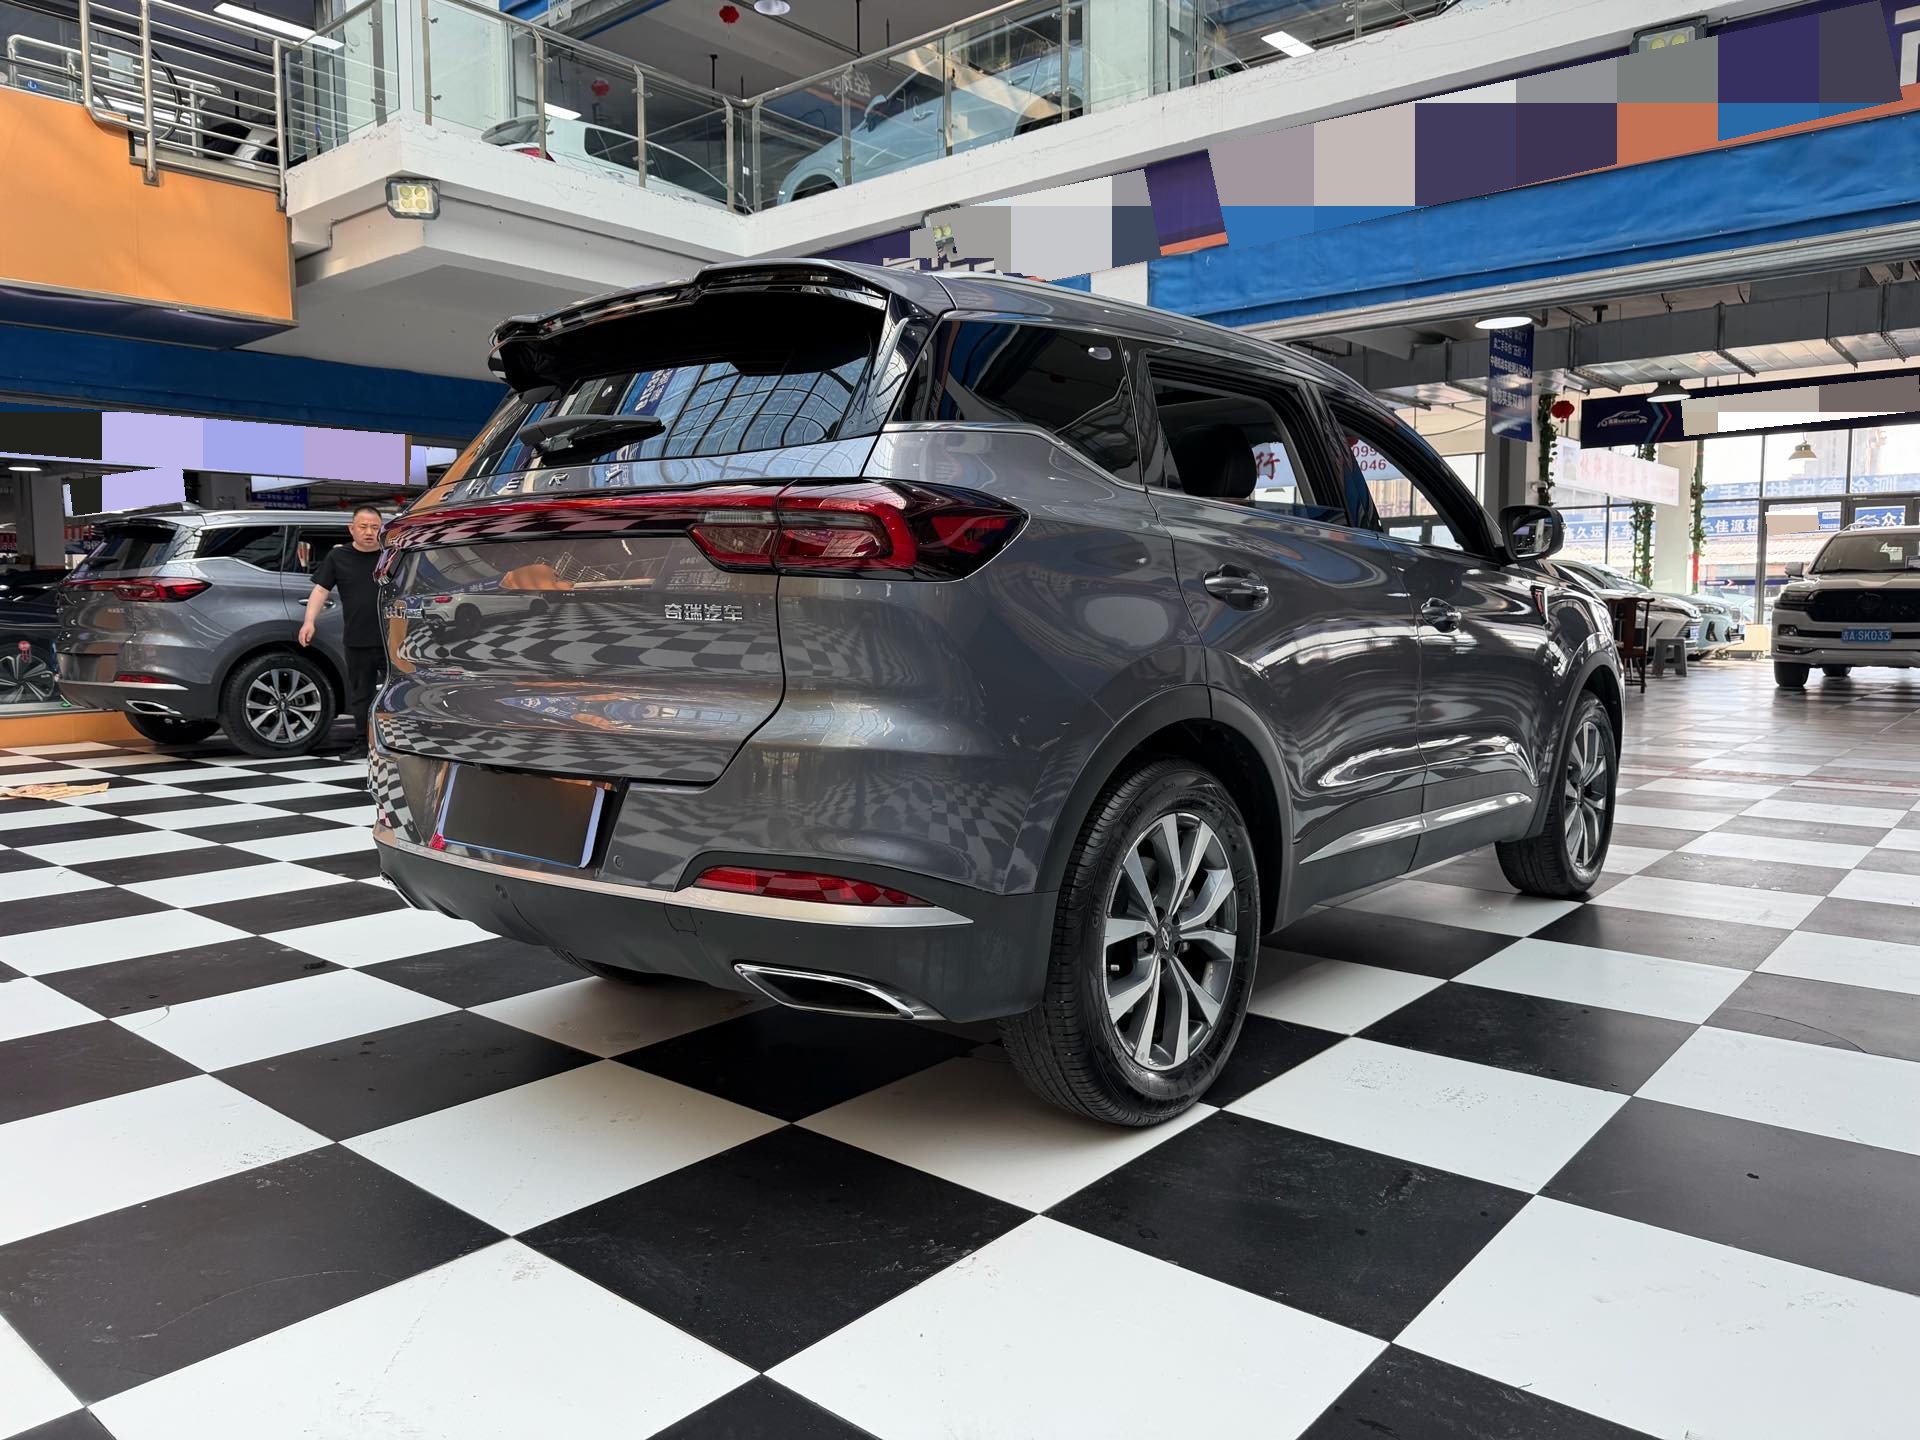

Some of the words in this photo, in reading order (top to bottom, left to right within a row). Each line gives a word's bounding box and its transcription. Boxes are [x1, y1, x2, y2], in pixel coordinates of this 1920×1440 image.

[1360, 459, 1387, 472] 046
[664, 603, 743, 621] 奇瑞汽车
